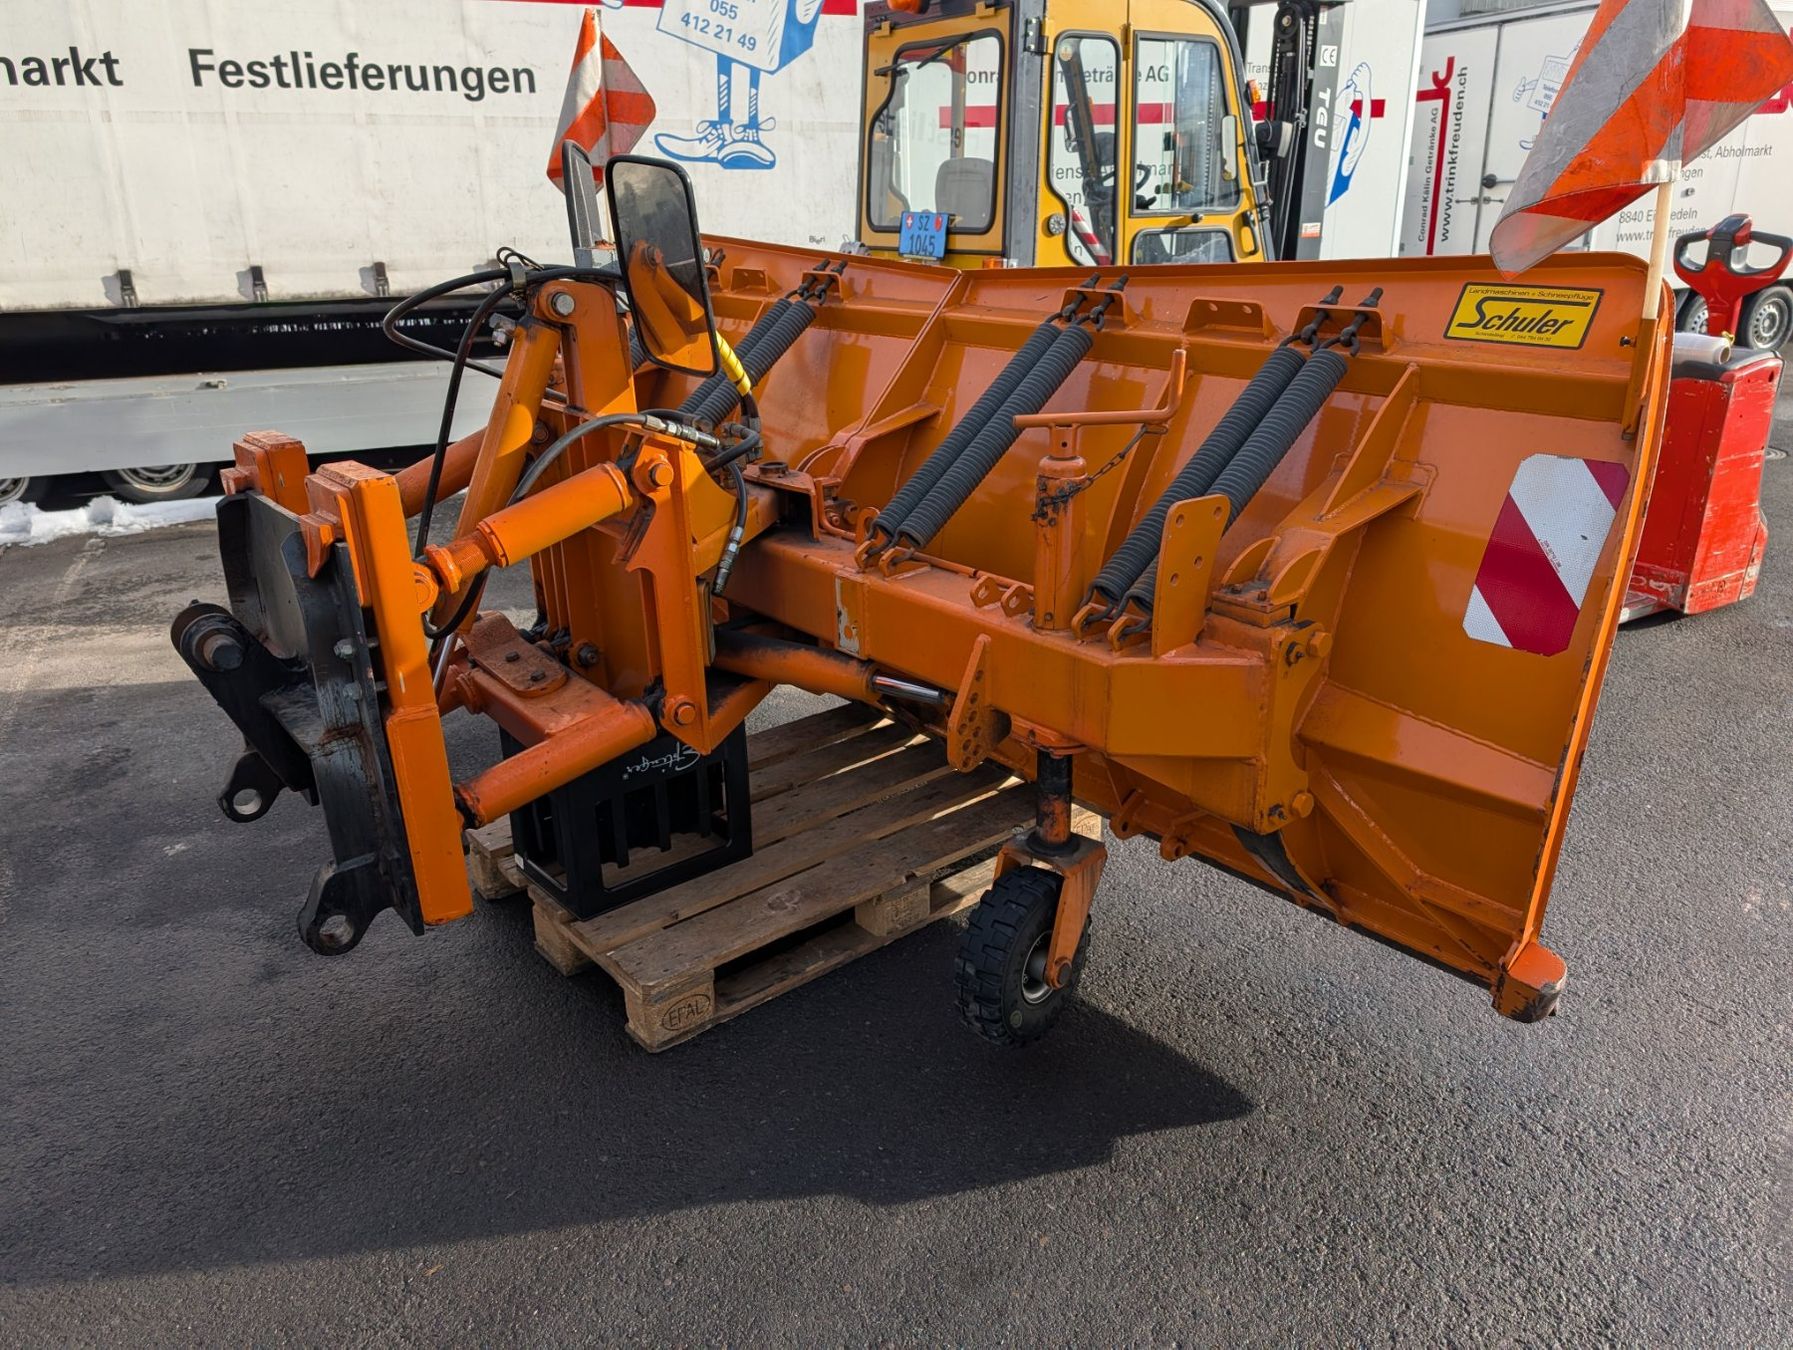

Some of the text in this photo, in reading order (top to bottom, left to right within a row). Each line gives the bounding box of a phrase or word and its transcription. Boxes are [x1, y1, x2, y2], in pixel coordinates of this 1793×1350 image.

[709, 0, 738, 20] 055
[681, 12, 756, 51] 412 21 49
[188, 48, 536, 101] Festlieferungen
[1144, 65, 1169, 82] AG
[1441, 66, 1468, 242] www.trinkfreuden.ch
[1715, 144, 1772, 158] Abholmarkt
[1418, 107, 1439, 242] Conrad Kälin Getränke AG
[918, 214, 930, 231] SZ
[1619, 210, 1644, 223] 8840
[909, 234, 936, 256] 1045
[1456, 296, 1592, 336] Schuler
